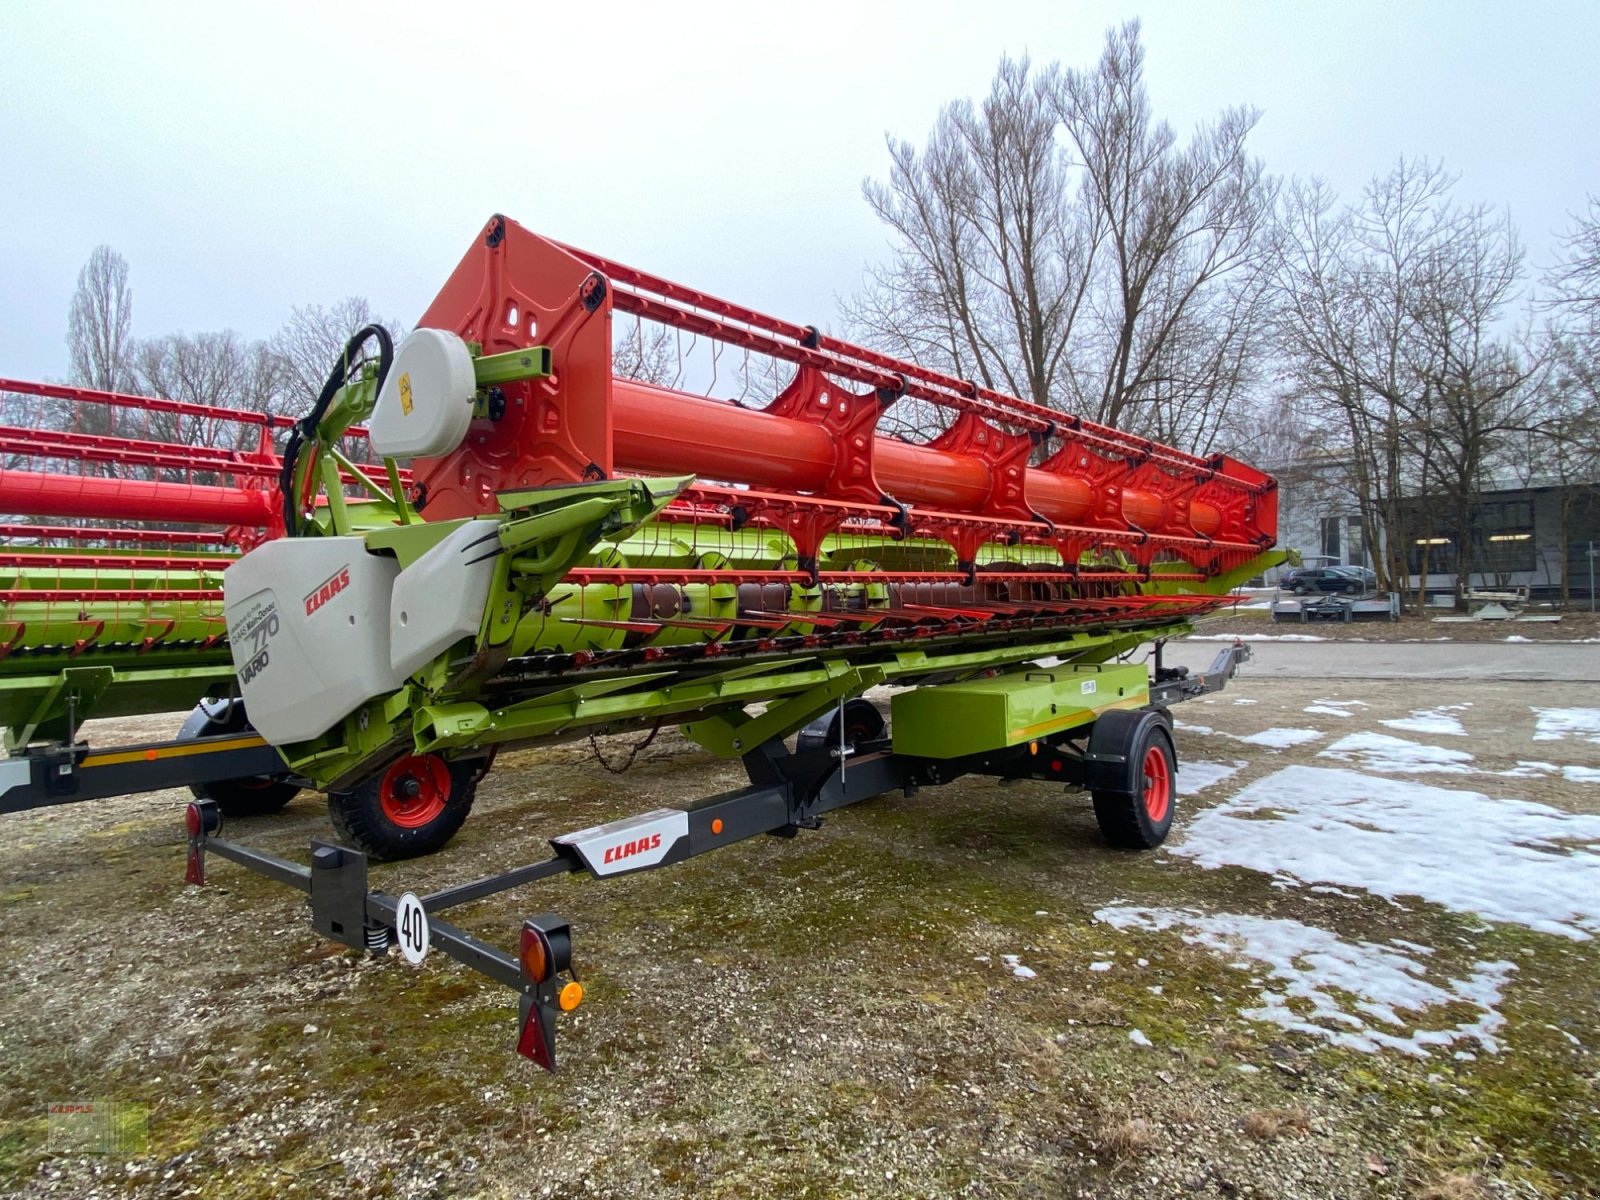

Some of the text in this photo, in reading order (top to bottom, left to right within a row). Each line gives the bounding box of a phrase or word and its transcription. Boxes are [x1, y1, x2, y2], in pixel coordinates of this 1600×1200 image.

[305, 568, 350, 617] CLAAS
[250, 613, 280, 654] 770
[241, 651, 269, 685] VARIO
[604, 833, 661, 864] CLAAS
[401, 903, 422, 952] 40
